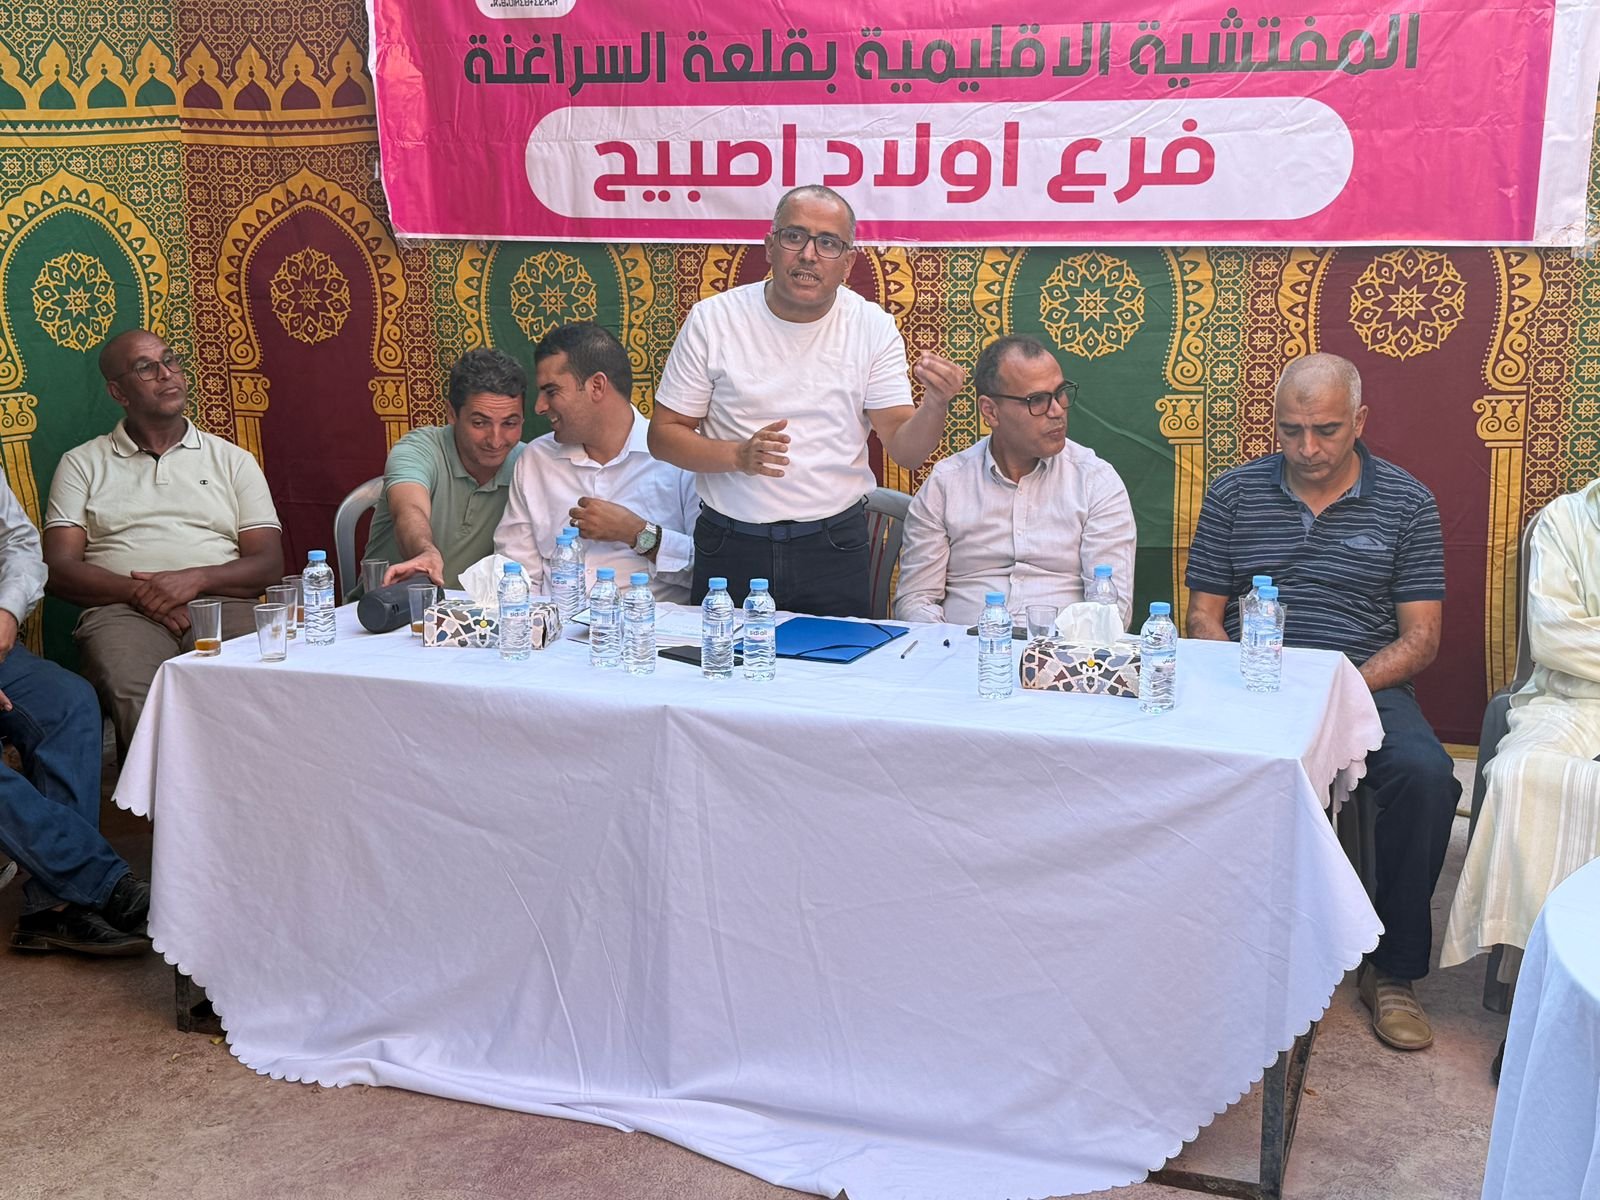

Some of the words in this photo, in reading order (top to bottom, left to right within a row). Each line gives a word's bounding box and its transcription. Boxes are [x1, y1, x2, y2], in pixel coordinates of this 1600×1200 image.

[463, 31, 667, 97] السراغنة
[682, 28, 837, 94] بقلعة
[854, 22, 1110, 94] الاقليمية
[1129, 8, 1420, 89] المفتشية
[593, 122, 797, 203] اصبيح
[822, 121, 1020, 204] اولاد
[1046, 118, 1216, 204] فرع
